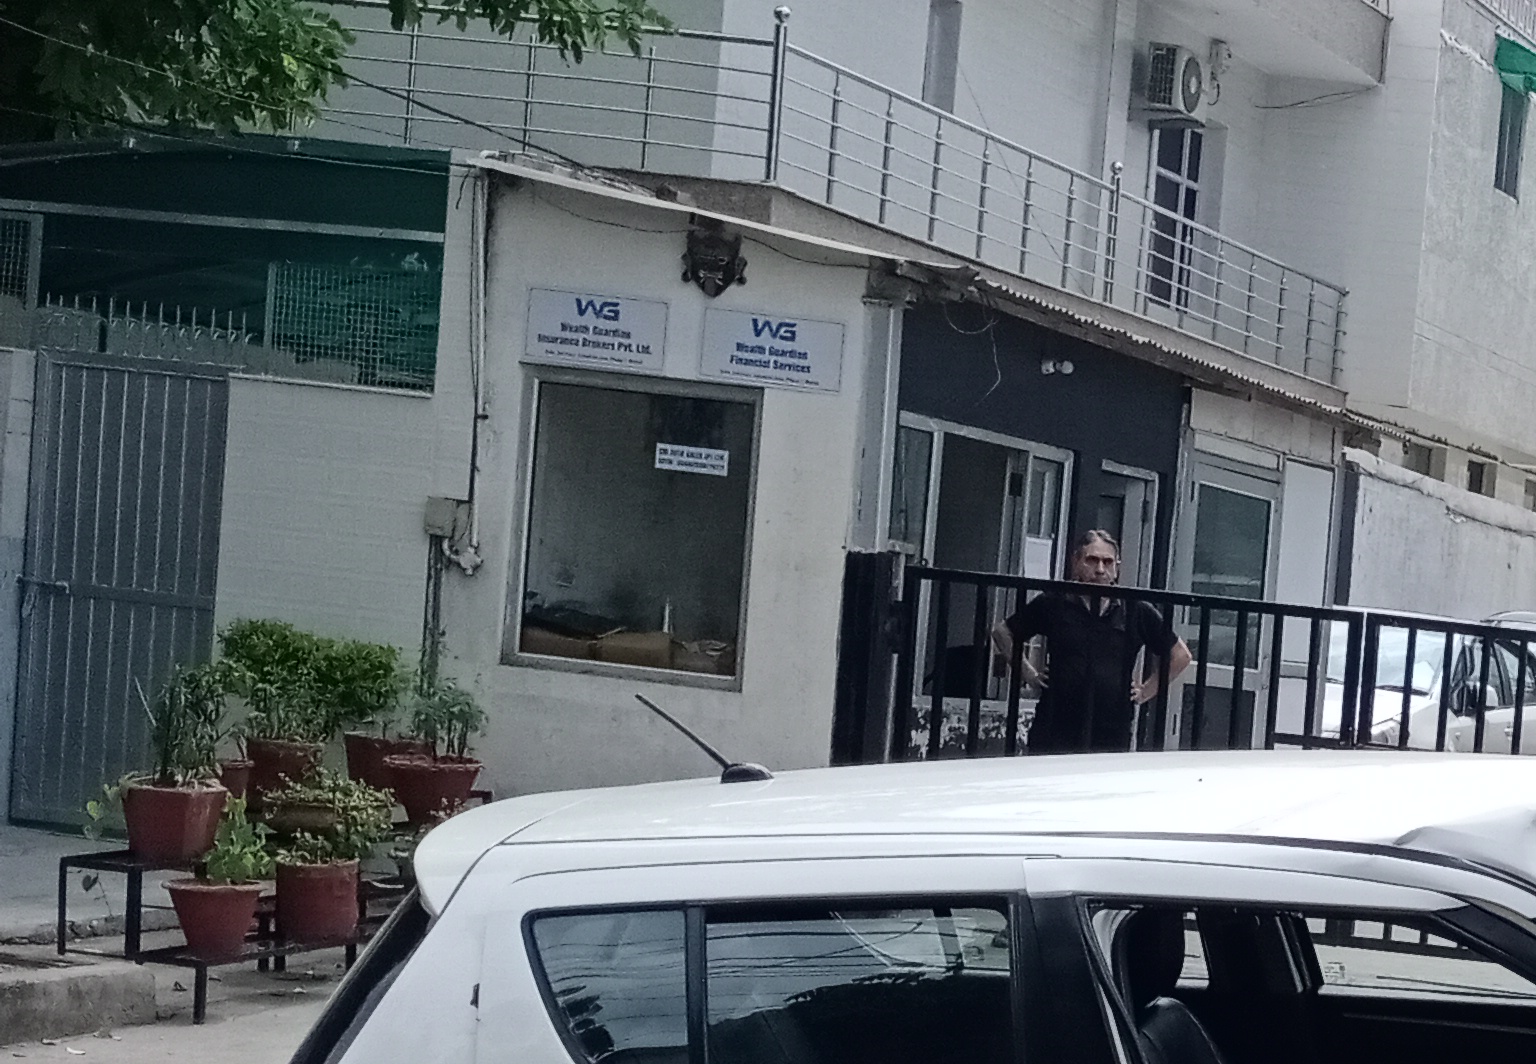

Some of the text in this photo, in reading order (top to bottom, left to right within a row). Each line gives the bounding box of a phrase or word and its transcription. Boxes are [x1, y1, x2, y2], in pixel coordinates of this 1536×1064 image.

[575, 297, 620, 321] WG
[752, 318, 797, 342] WG
[730, 354, 811, 374] Financial Services
